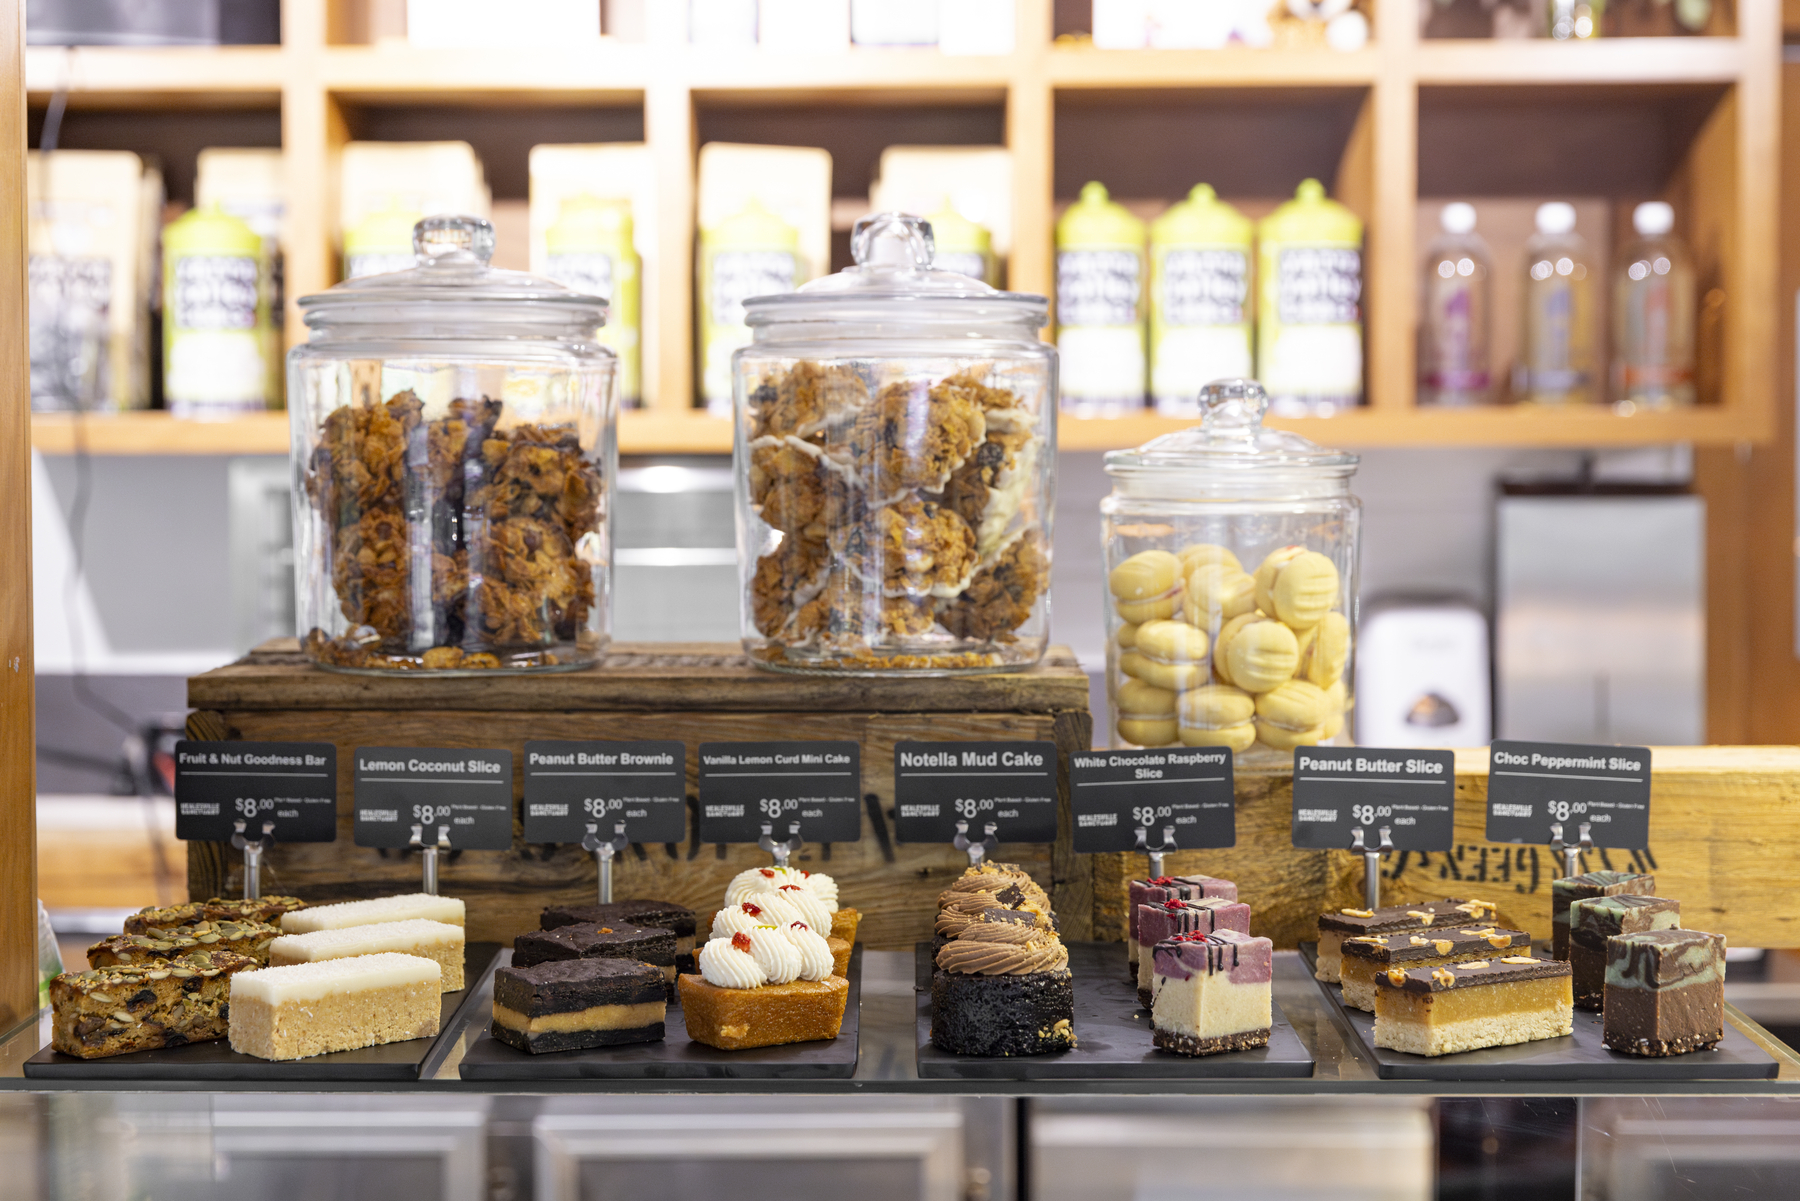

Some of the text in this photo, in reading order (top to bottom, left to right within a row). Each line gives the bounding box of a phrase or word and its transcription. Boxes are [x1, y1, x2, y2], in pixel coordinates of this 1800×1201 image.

[178, 752, 327, 766] Fruit & Nut Goodness Bar
[529, 752, 674, 766] Peanut Butter Brownie
[702, 753, 851, 766] Vanilla Lemon Curd Mini Cake
[900, 751, 1044, 767] Notella Mud Cake
[1073, 752, 1227, 769] White Chocolate Raspberry
[1299, 756, 1444, 775] Peanut Butter Slice
[1493, 751, 1642, 772] Choc Peppermint Slice
[359, 758, 502, 774] Lemon Coconut Slice
[1134, 767, 1164, 780] Slice
[276, 809, 299, 818] each
[625, 808, 648, 818] each
[801, 808, 824, 818] each
[997, 808, 1019, 818] each
[1175, 814, 1198, 825] each
[1589, 813, 1612, 823] each
[453, 816, 475, 825] each
[1393, 816, 1417, 826] each
